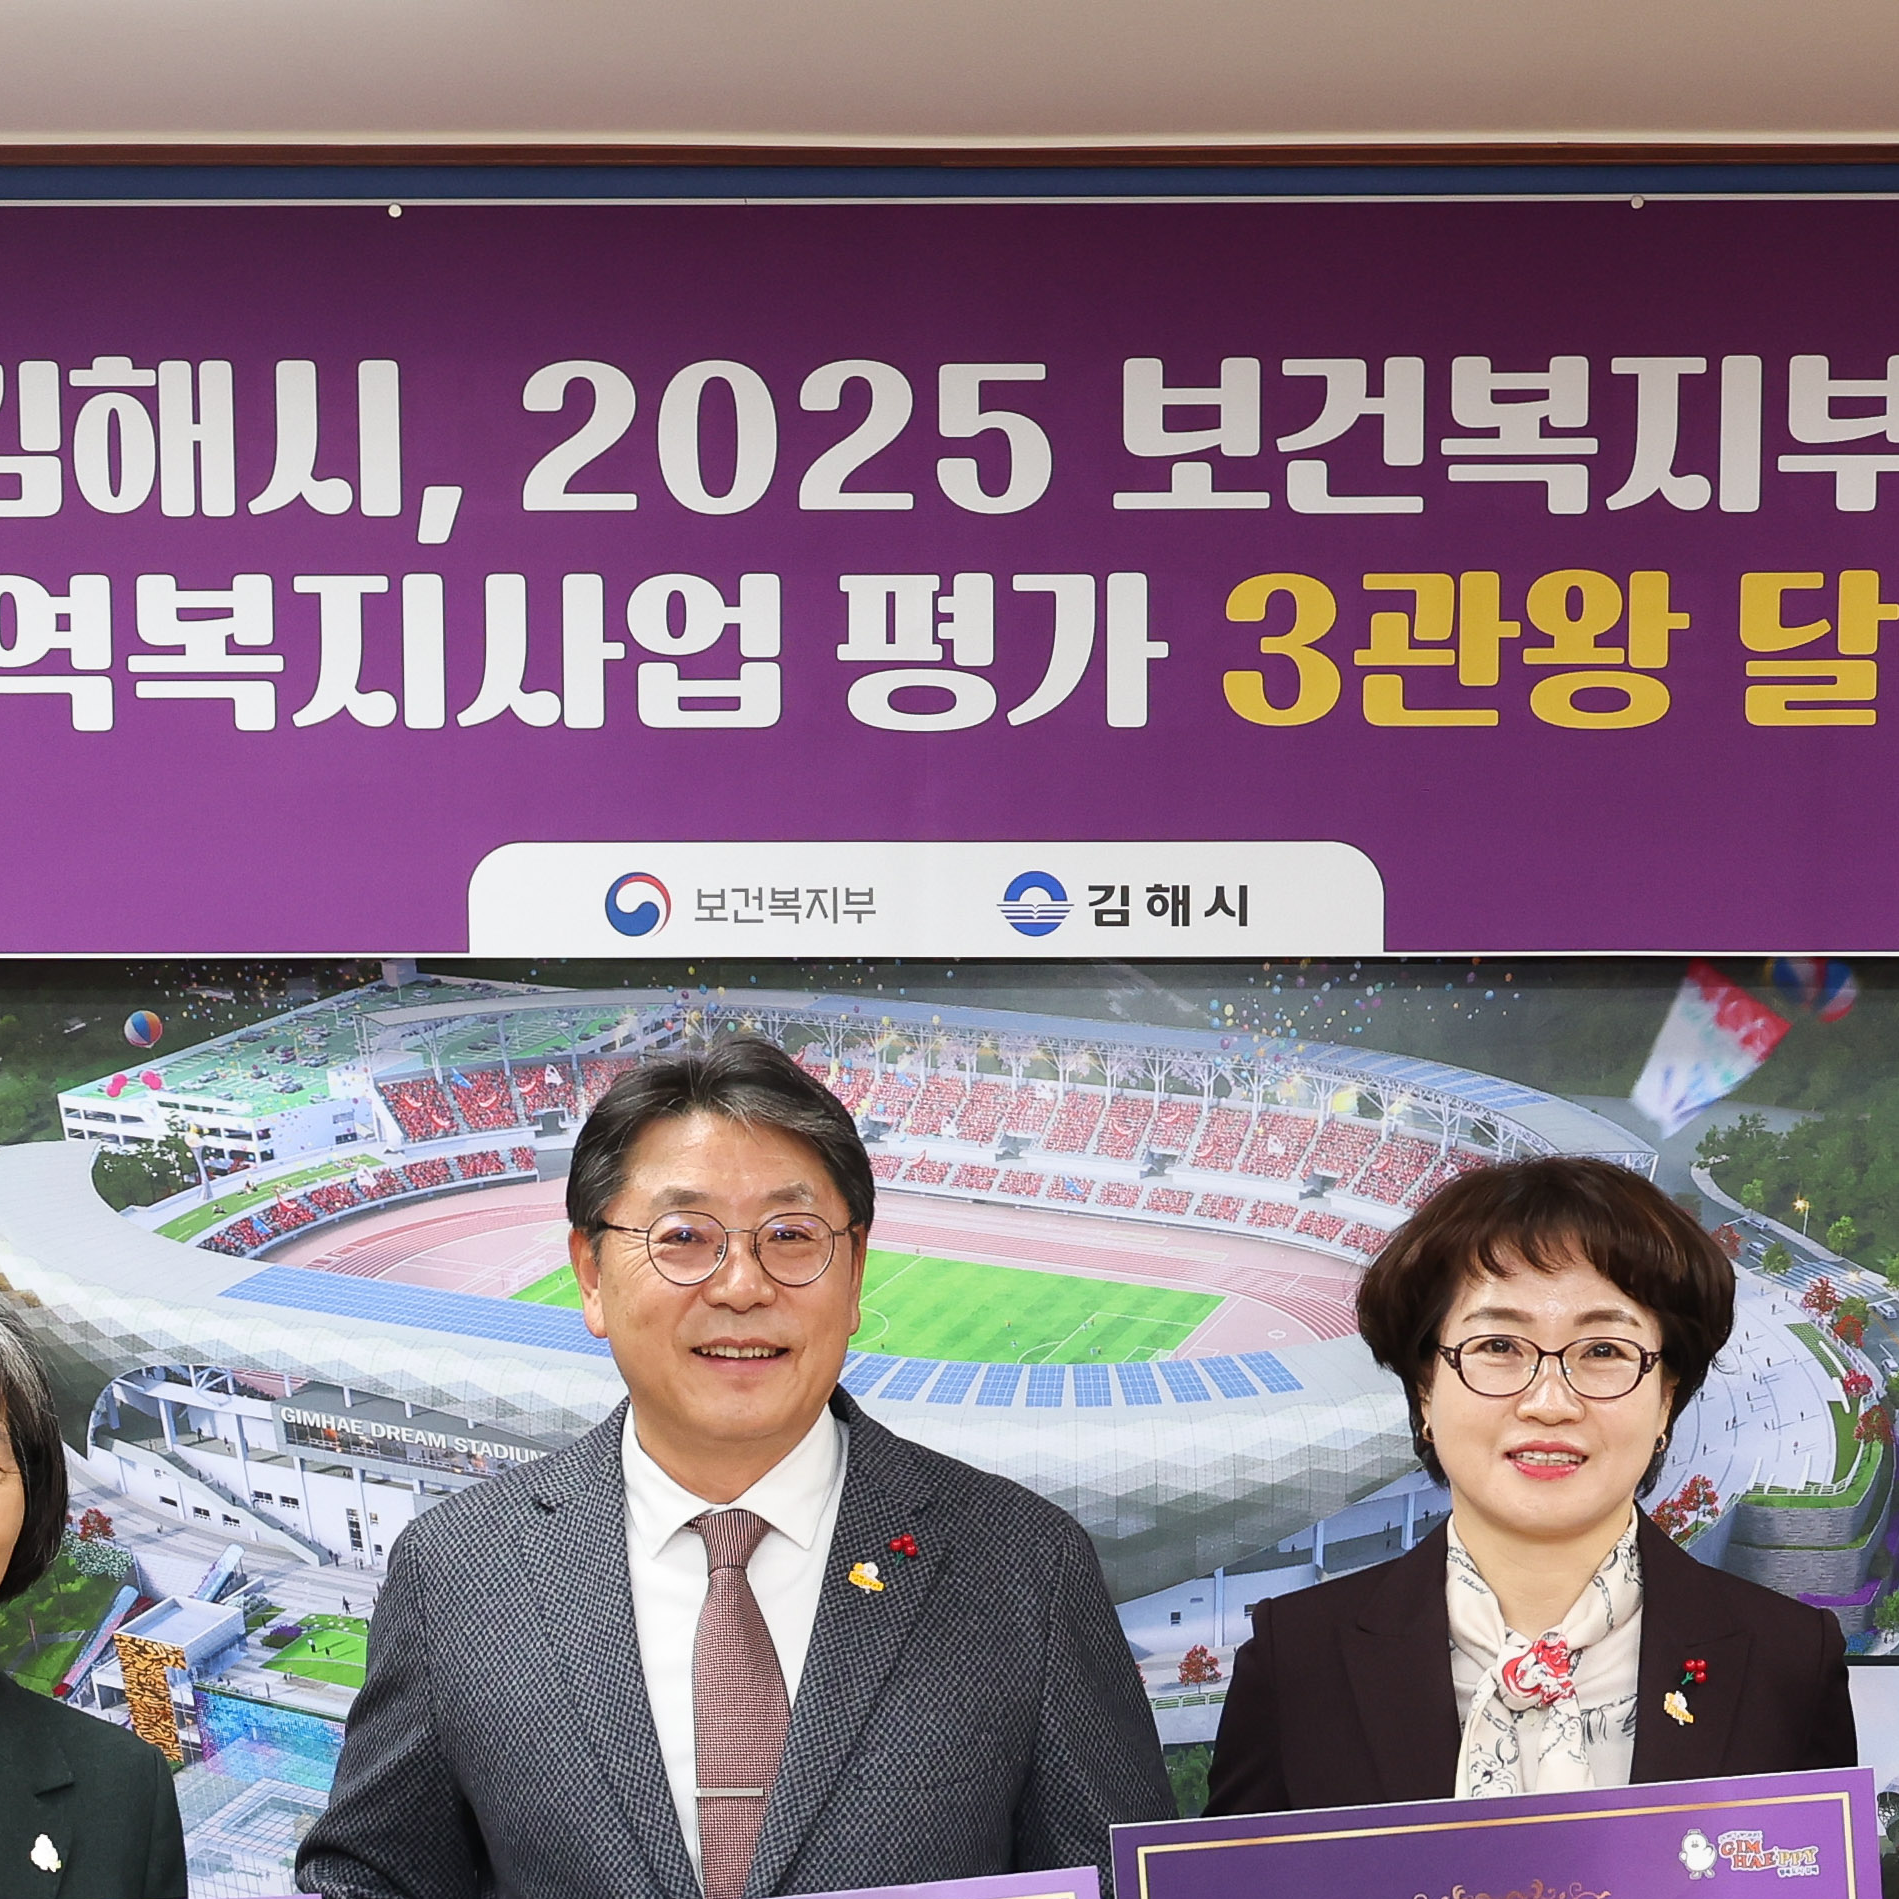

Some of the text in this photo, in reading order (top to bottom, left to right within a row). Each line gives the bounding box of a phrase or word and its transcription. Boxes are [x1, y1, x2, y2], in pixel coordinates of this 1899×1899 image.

[520, 357, 1054, 517] 2025
[834, 570, 1171, 734] 평가
[1220, 567, 1692, 732] 3관왕
[693, 885, 878, 926] 보건복지부
[1086, 883, 1251, 928] 김해시
[280, 1406, 550, 1463] GIMHAE DREAM STADIUM
